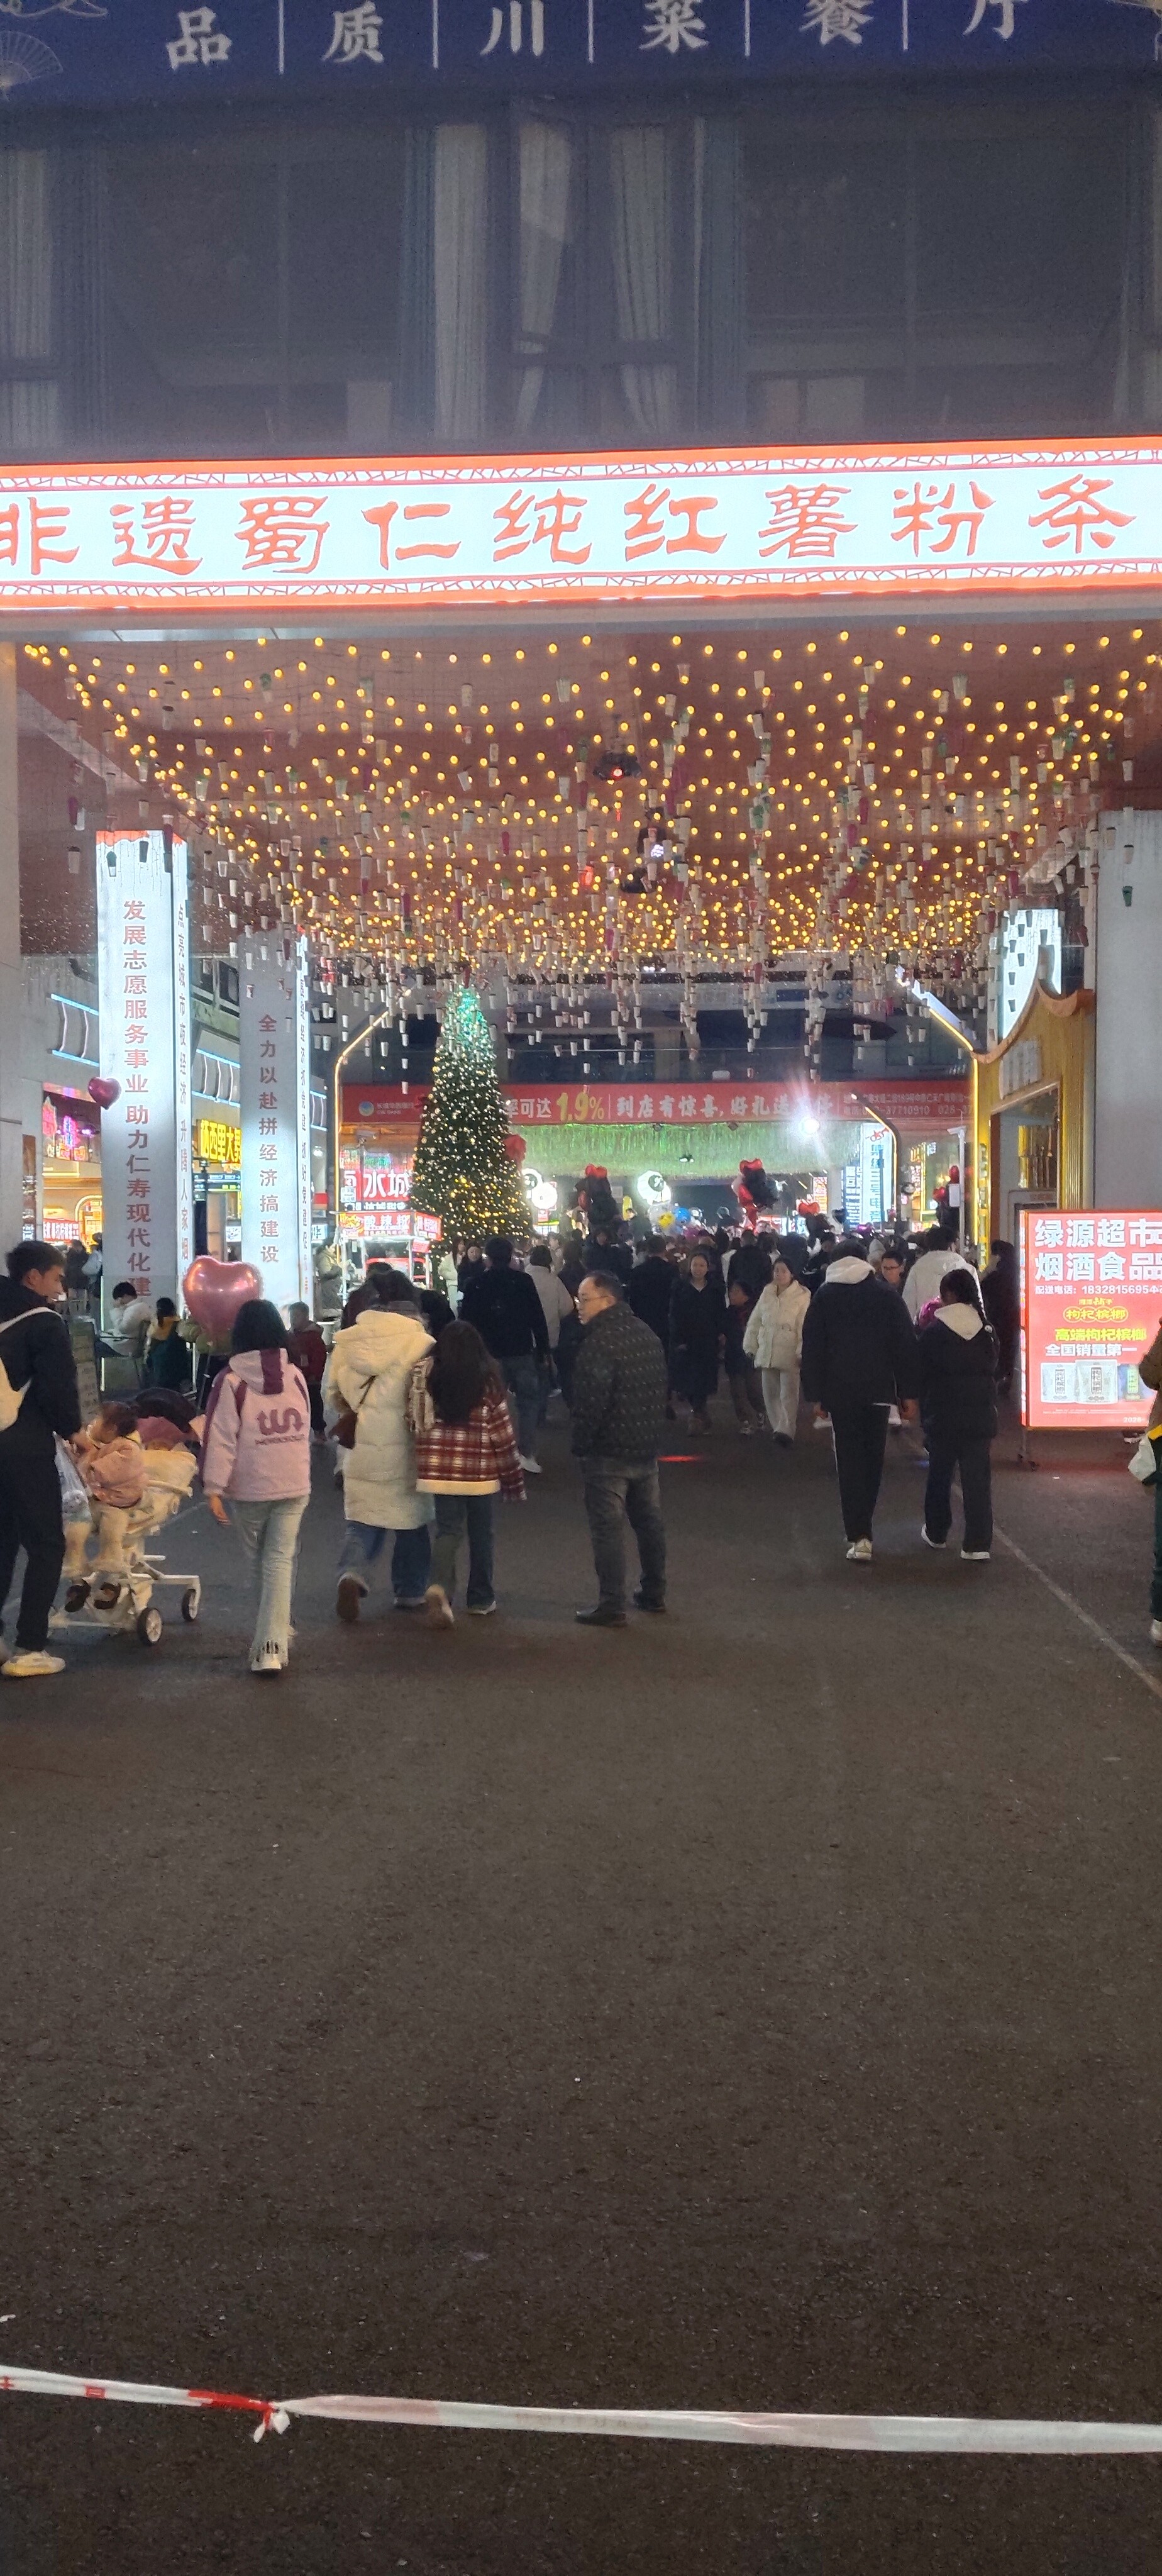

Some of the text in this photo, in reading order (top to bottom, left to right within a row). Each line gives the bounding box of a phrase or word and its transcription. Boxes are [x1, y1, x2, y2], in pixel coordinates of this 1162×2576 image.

[0, 474, 1136, 575] 非遗蜀仁纯红薯粉条
[123, 900, 150, 1094] 发展志愿服务事业
[258, 1014, 279, 1263] 全力以赴拼经济搞建设
[180, 1119, 189, 1275] 升腾人家烟
[363, 1169, 409, 1198] 水城
[1034, 1218, 1159, 1248] 绿源超市
[1034, 1251, 1159, 1282] 烟酒食品
[1066, 1309, 1126, 1320] 枸杞槟榔
[1054, 1328, 1148, 1341] 高端枸杞槟榔
[1044, 1343, 1137, 1357] 全国销量第一
